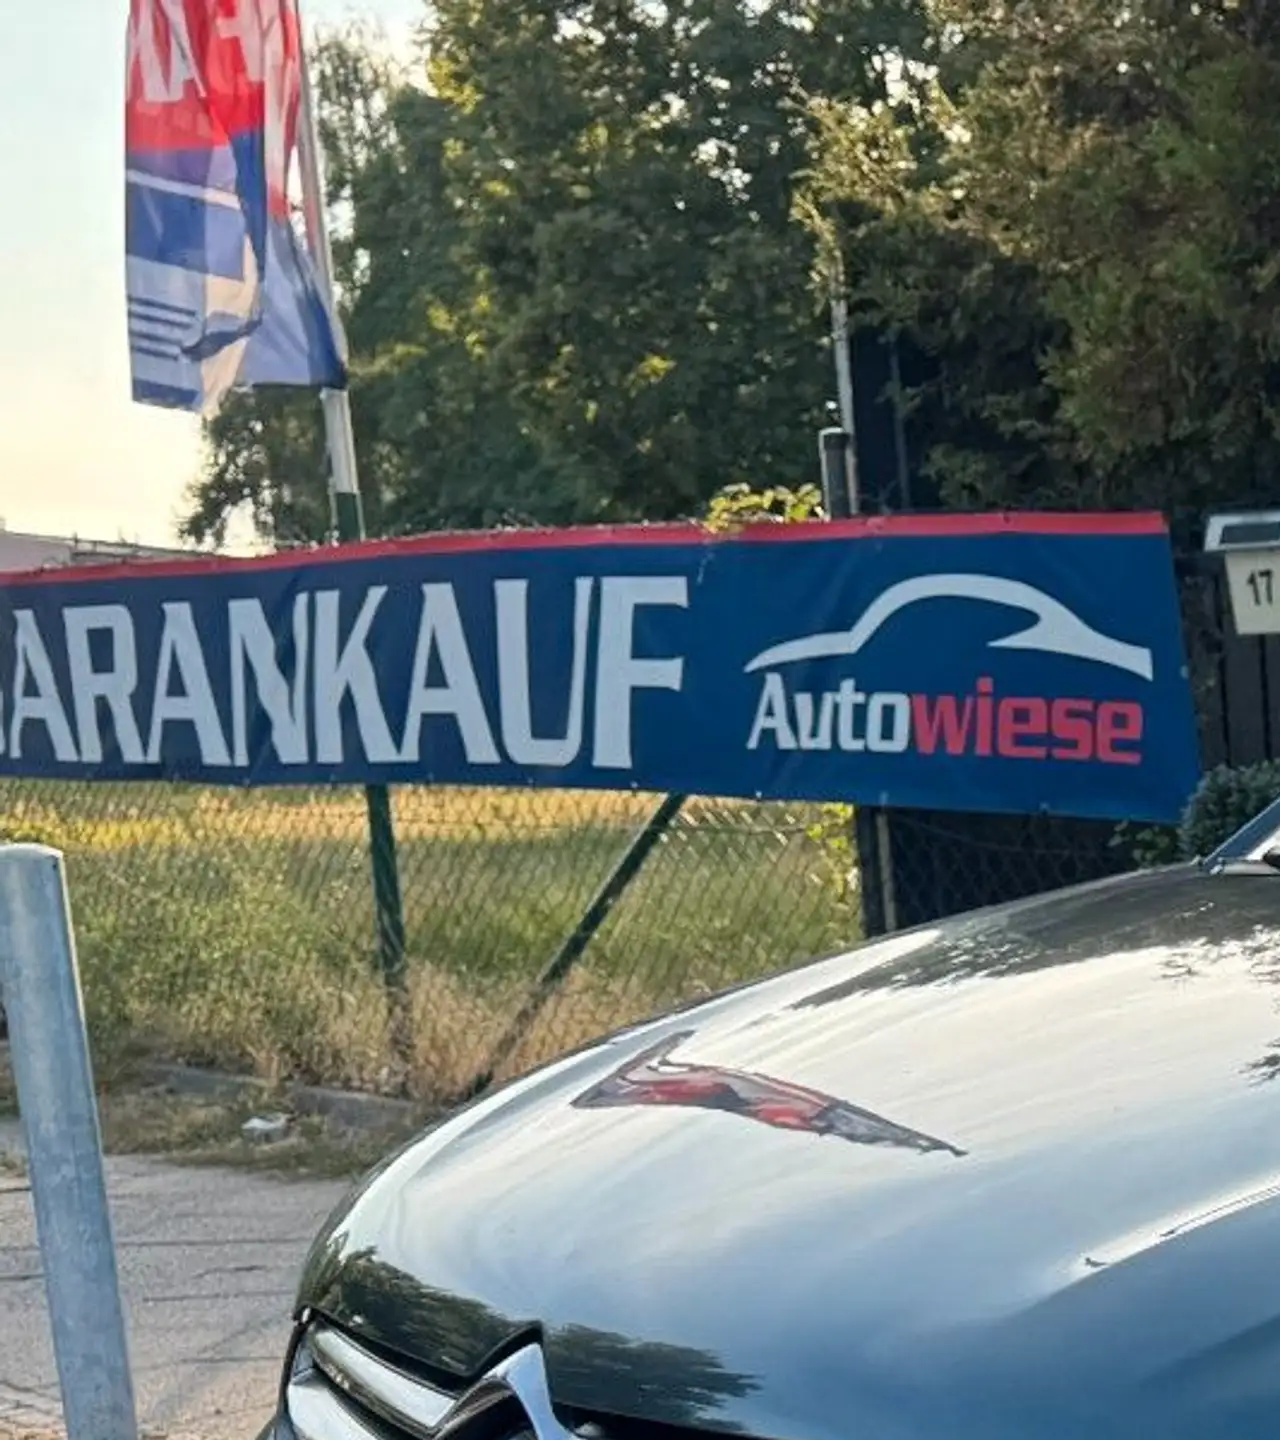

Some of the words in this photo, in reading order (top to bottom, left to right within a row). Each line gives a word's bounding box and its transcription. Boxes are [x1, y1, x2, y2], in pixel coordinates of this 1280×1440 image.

[1246, 569, 1275, 606] 17
[0, 575, 688, 768] ARANKAUF
[746, 671, 1143, 766] Autowiese
